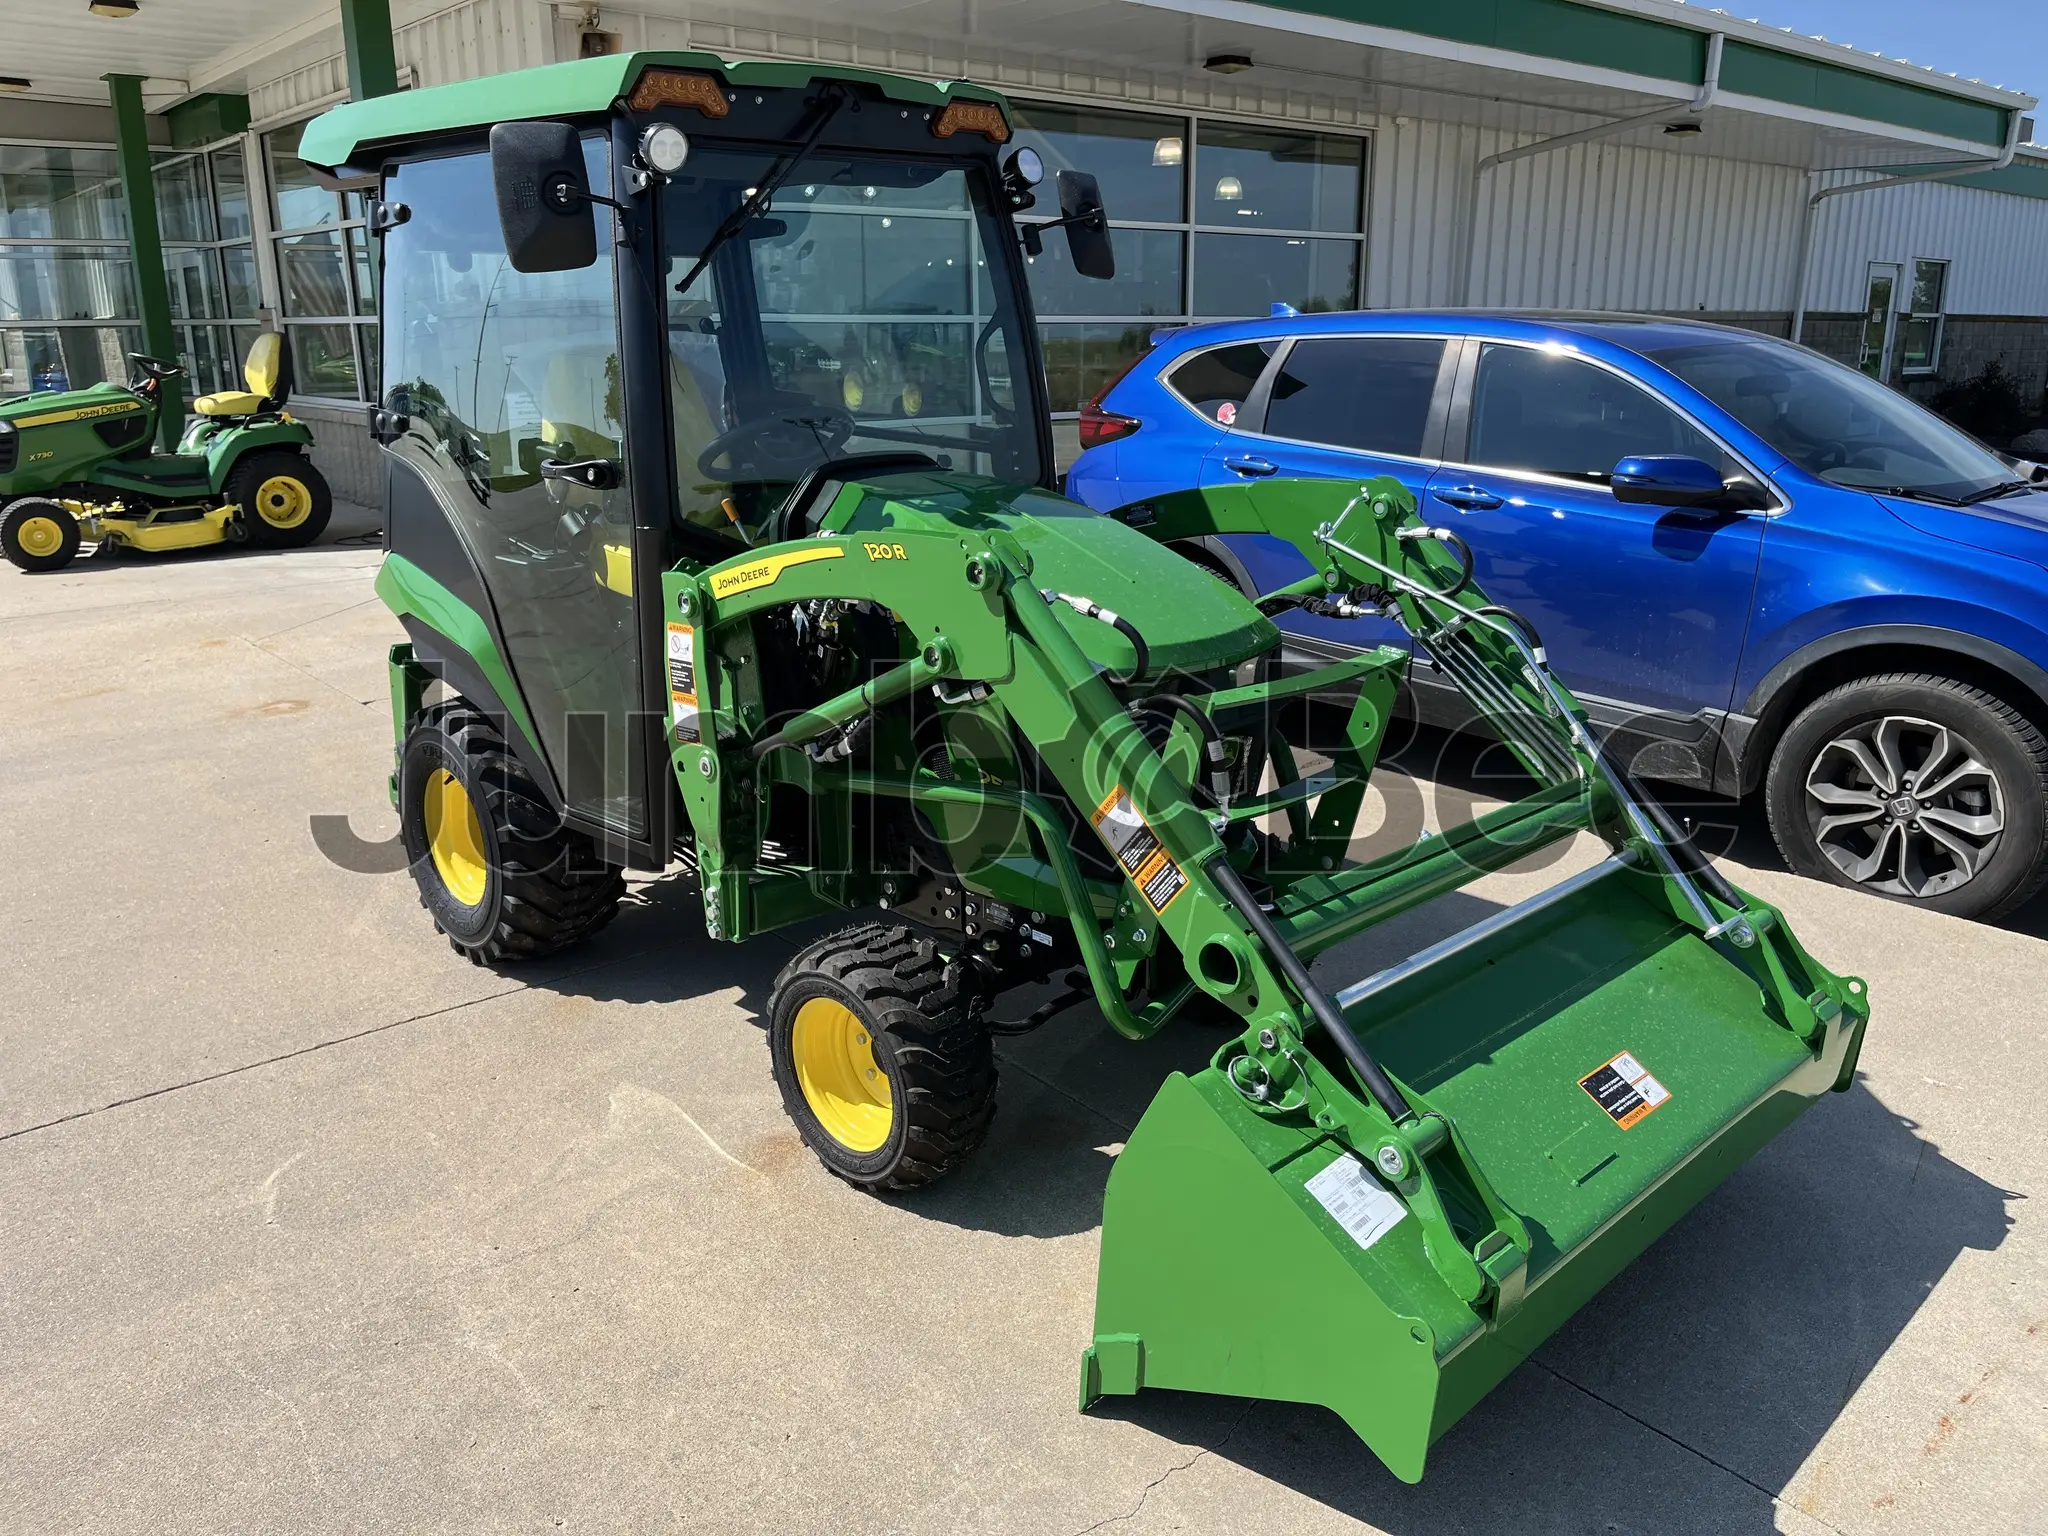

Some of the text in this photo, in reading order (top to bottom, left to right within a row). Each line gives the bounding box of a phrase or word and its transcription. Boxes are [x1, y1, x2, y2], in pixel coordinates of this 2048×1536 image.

[76, 403, 132, 420] JOHN DEERE
[29, 451, 54, 461] X730
[718, 566, 770, 590] JOHN DEERE
[1146, 854, 1167, 878] WARNING
